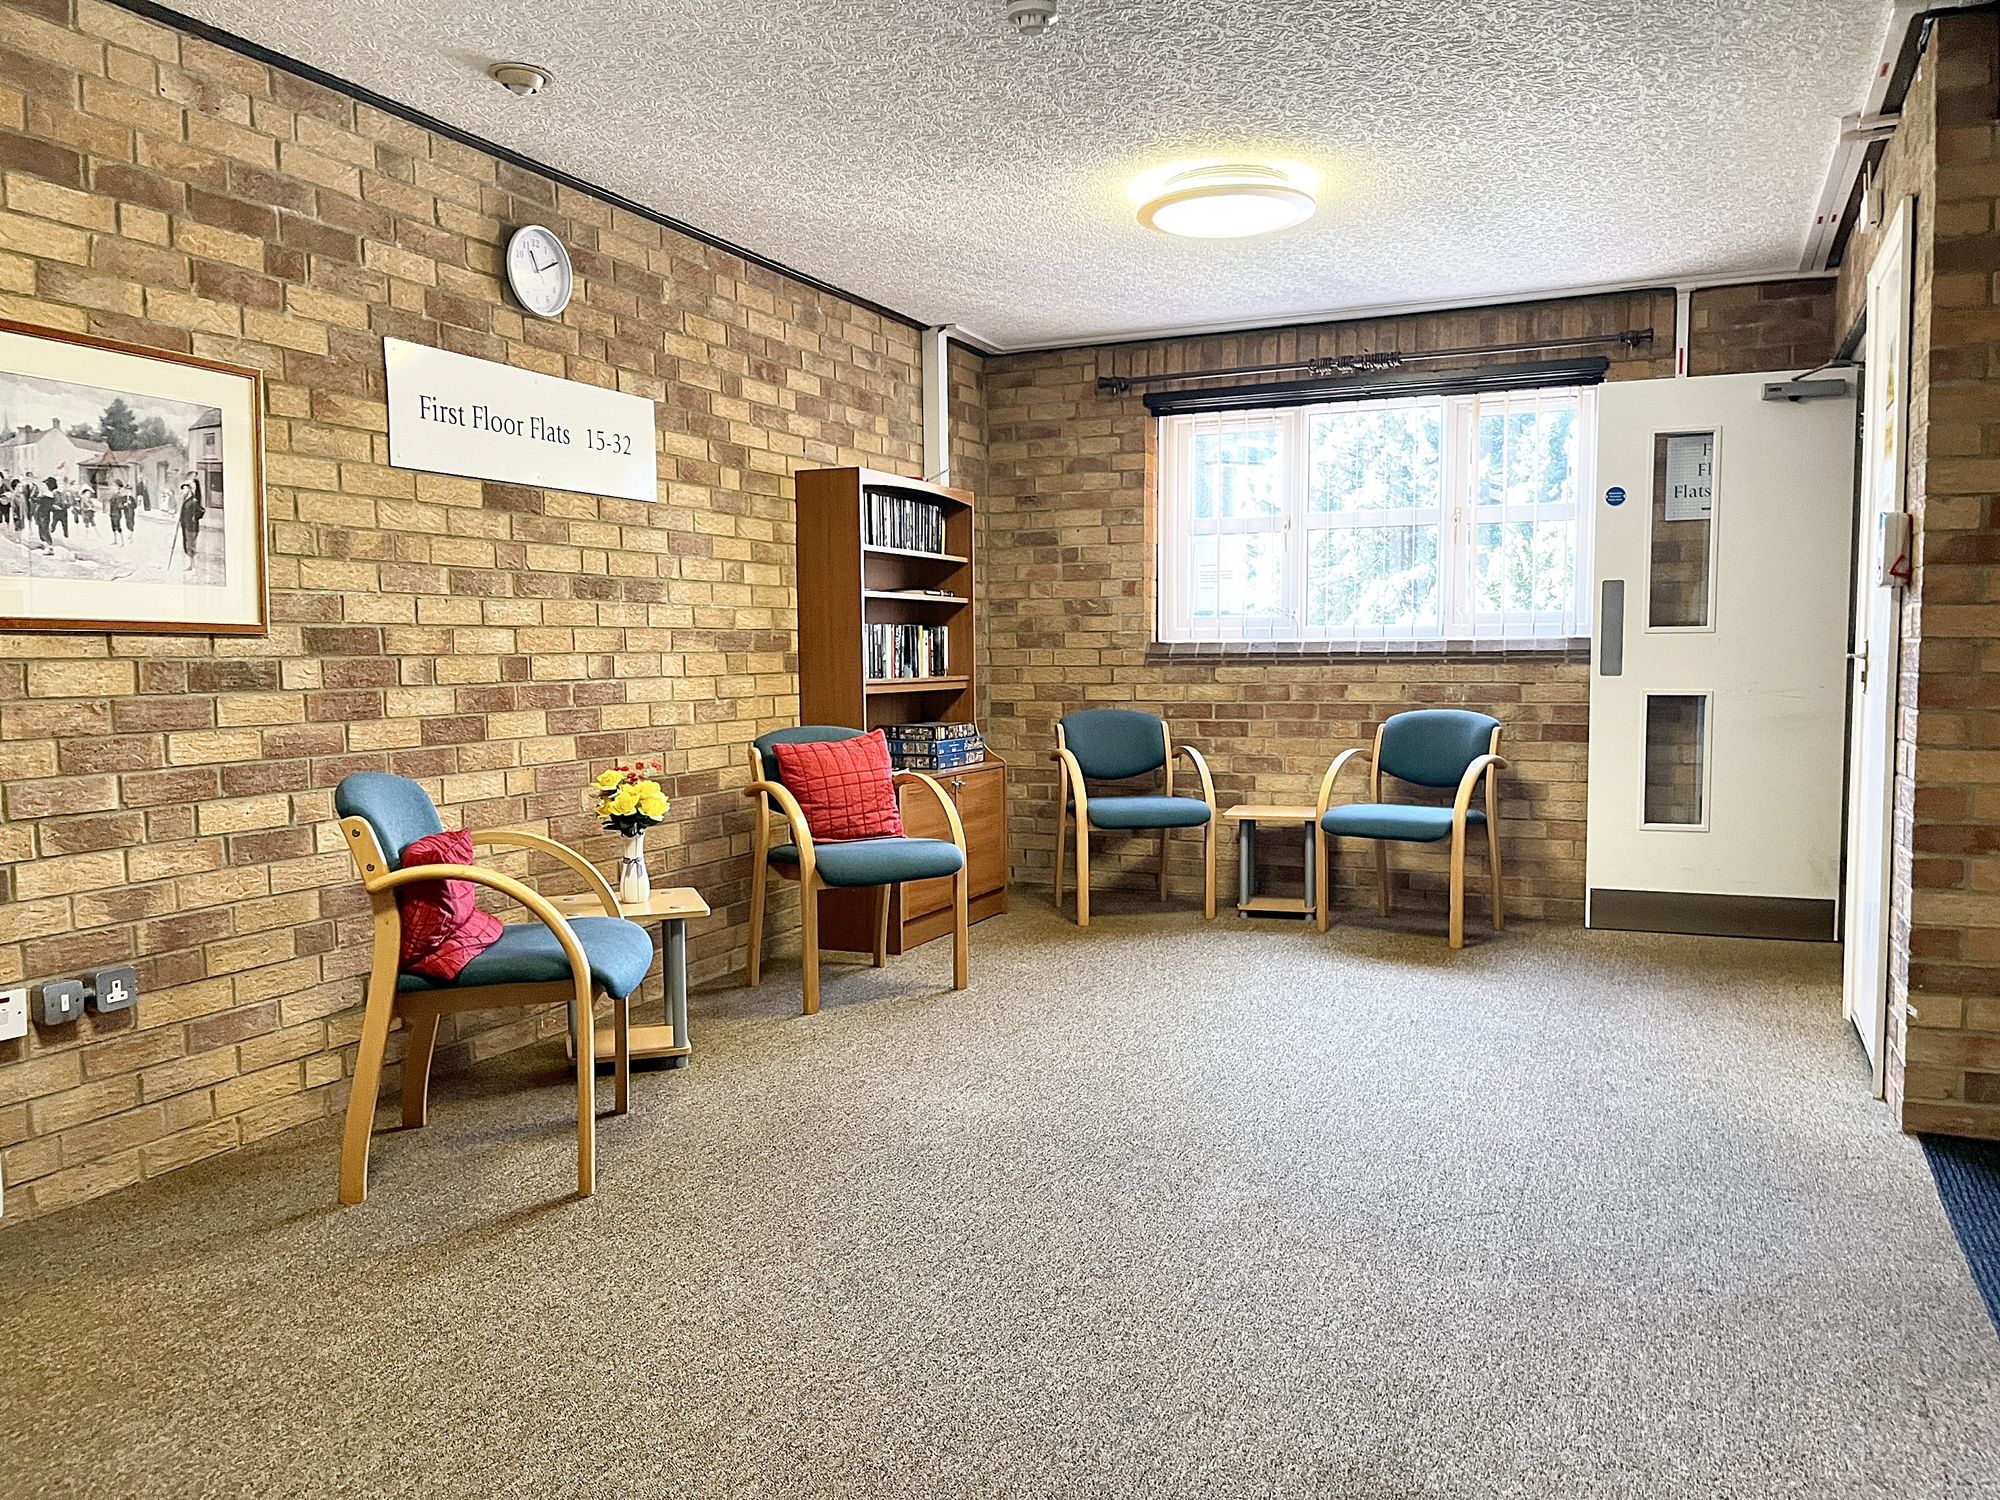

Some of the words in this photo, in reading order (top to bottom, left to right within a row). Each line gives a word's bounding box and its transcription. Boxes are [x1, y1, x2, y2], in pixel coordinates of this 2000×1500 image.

[418, 394, 466, 427] First
[472, 405, 525, 437] Floor
[529, 416, 572, 446] Flats
[586, 428, 633, 456] 15-32
[1674, 484, 1712, 499] Flats
